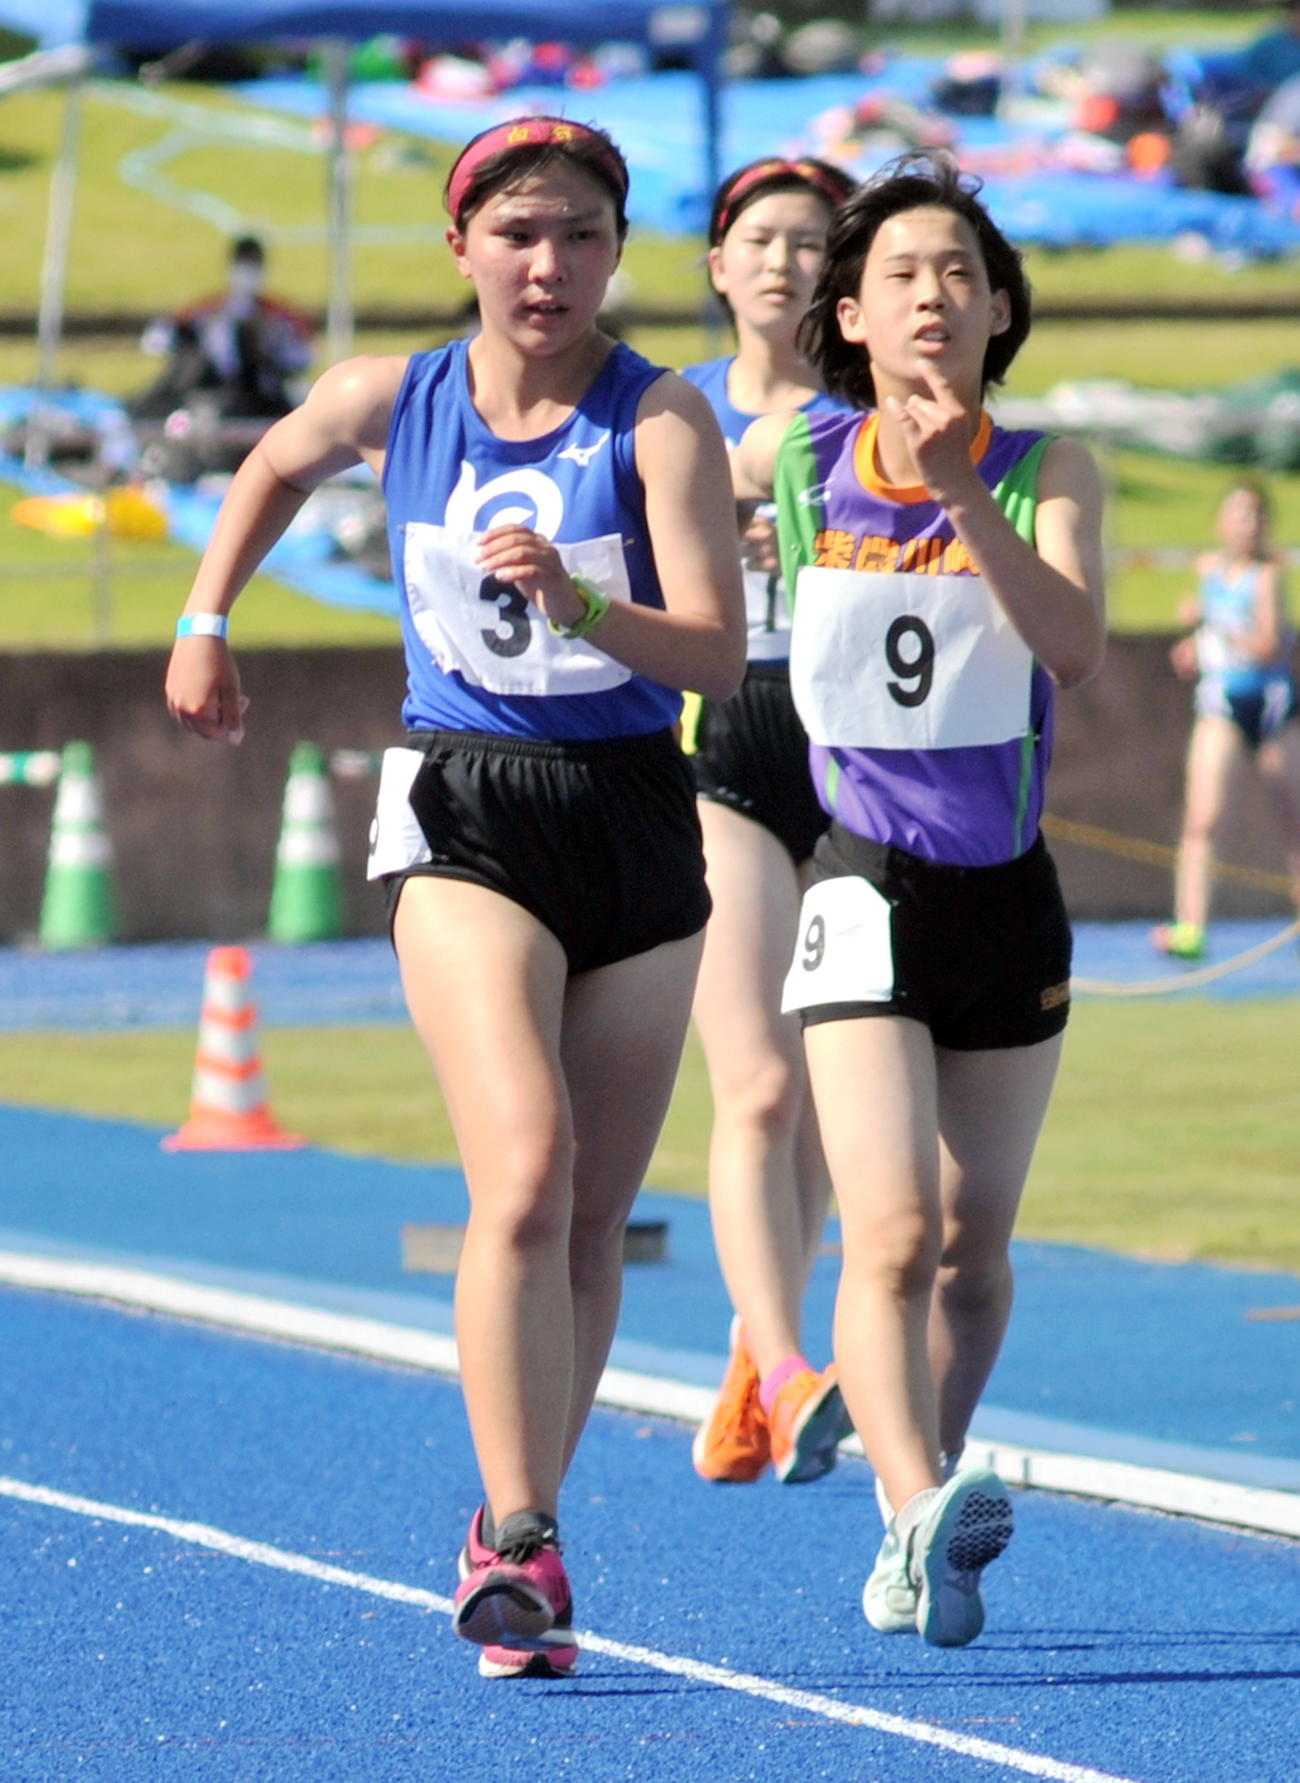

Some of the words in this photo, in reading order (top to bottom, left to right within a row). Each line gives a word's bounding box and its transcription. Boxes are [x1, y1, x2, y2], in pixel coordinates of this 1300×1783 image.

[480, 573, 532, 658] 3
[885, 614, 935, 708] 9
[802, 914, 826, 972] 9
